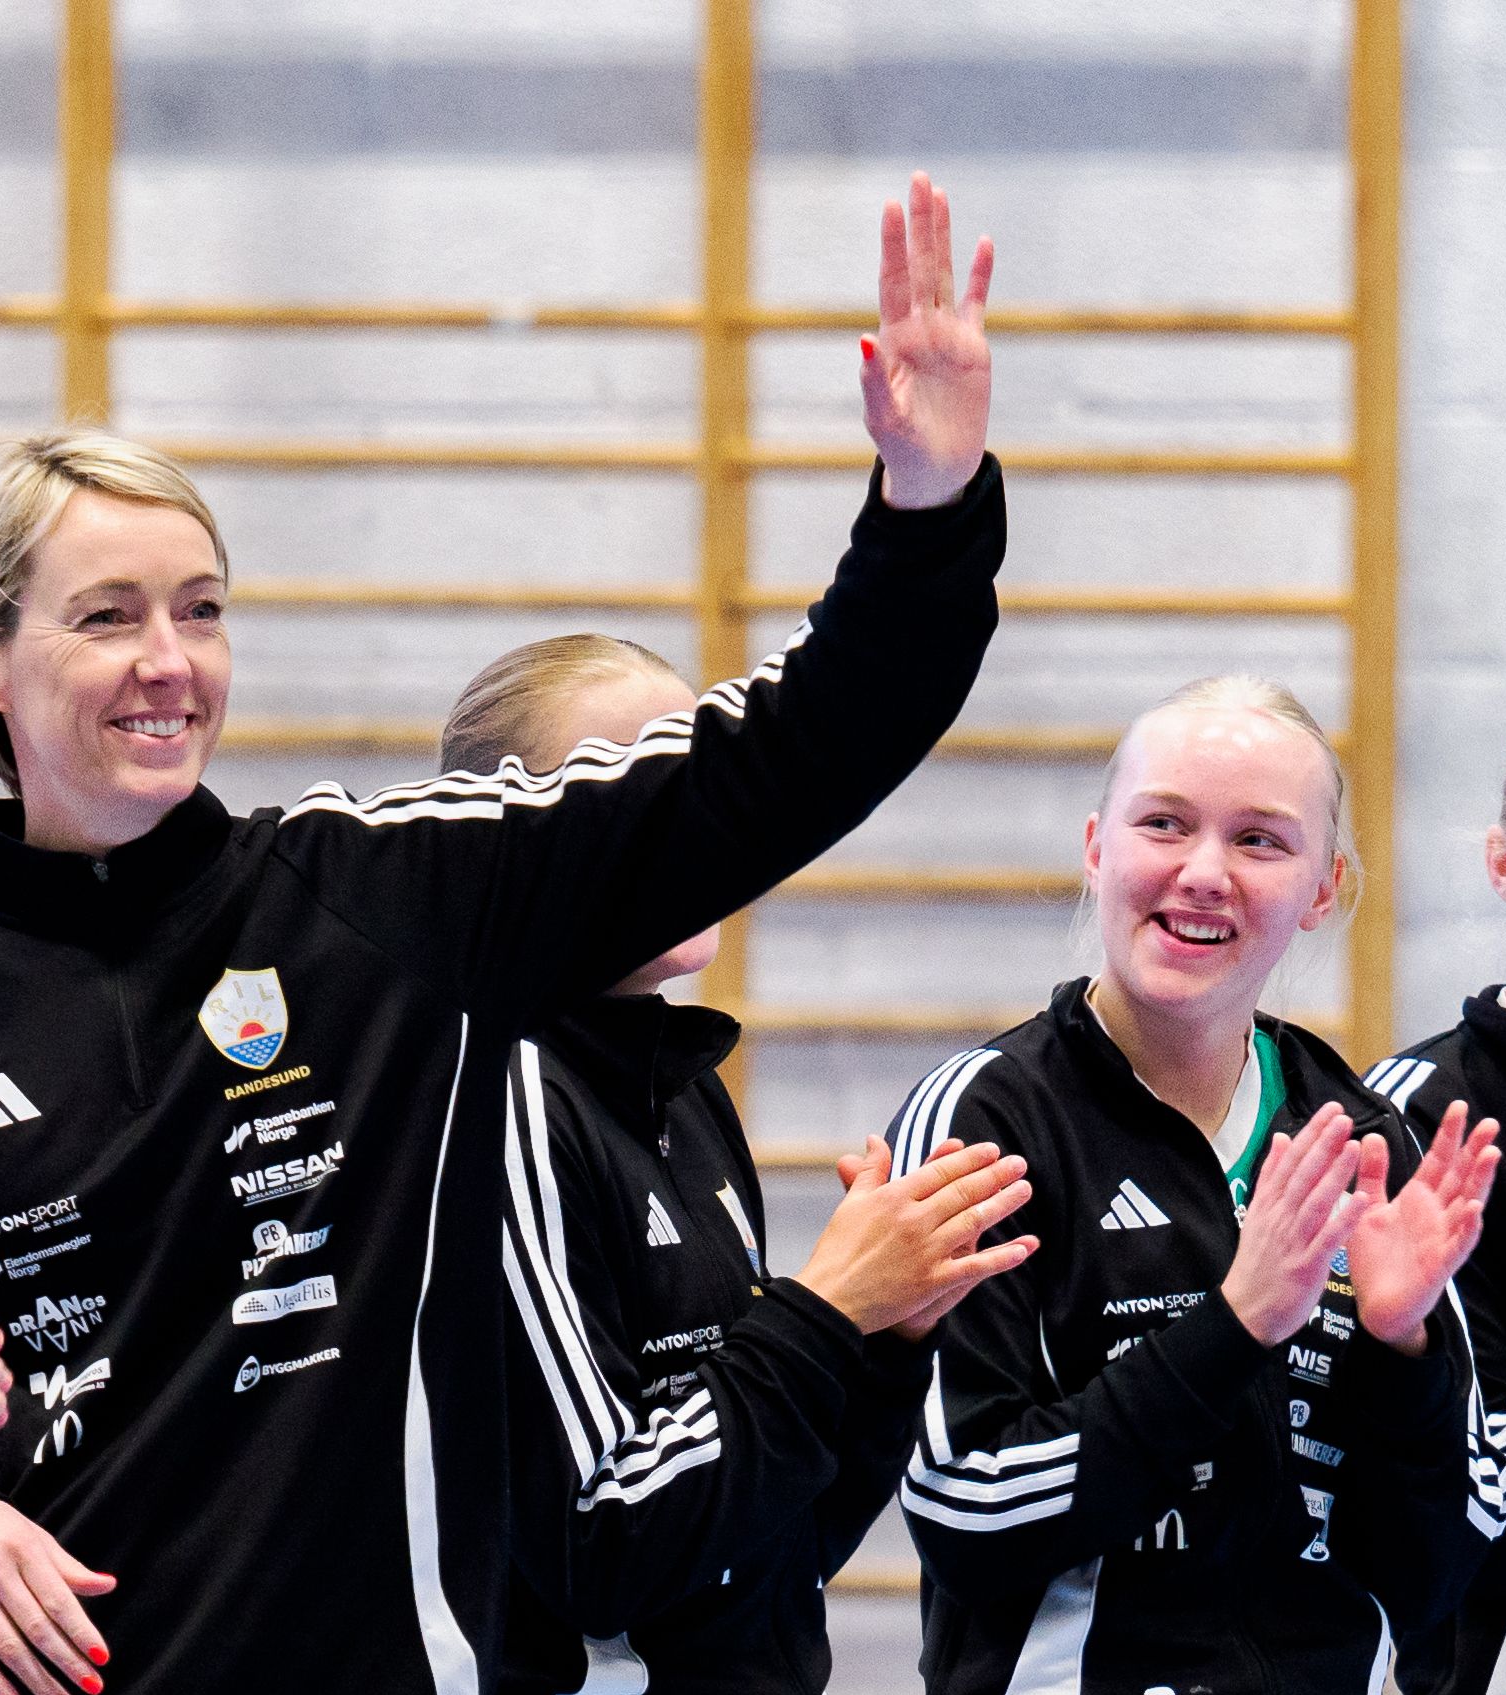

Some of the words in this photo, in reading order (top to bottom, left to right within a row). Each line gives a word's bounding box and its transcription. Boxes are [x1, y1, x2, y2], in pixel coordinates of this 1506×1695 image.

[224, 1065, 311, 1100] RANDESUND
[253, 1100, 335, 1132] Sparebanken
[256, 1125, 297, 1144] Norge
[230, 1140, 344, 1197] NISSAN
[260, 1223, 280, 1246] PB
[3, 1234, 92, 1270] Eiendomsmegler
[7, 1263, 41, 1280] Norge
[1103, 1292, 1207, 1316] ANTONSPORT
[1323, 1320, 1350, 1341] Norge
[262, 1347, 341, 1376] BYGGMAKKER
[1287, 1344, 1332, 1376] NIS
